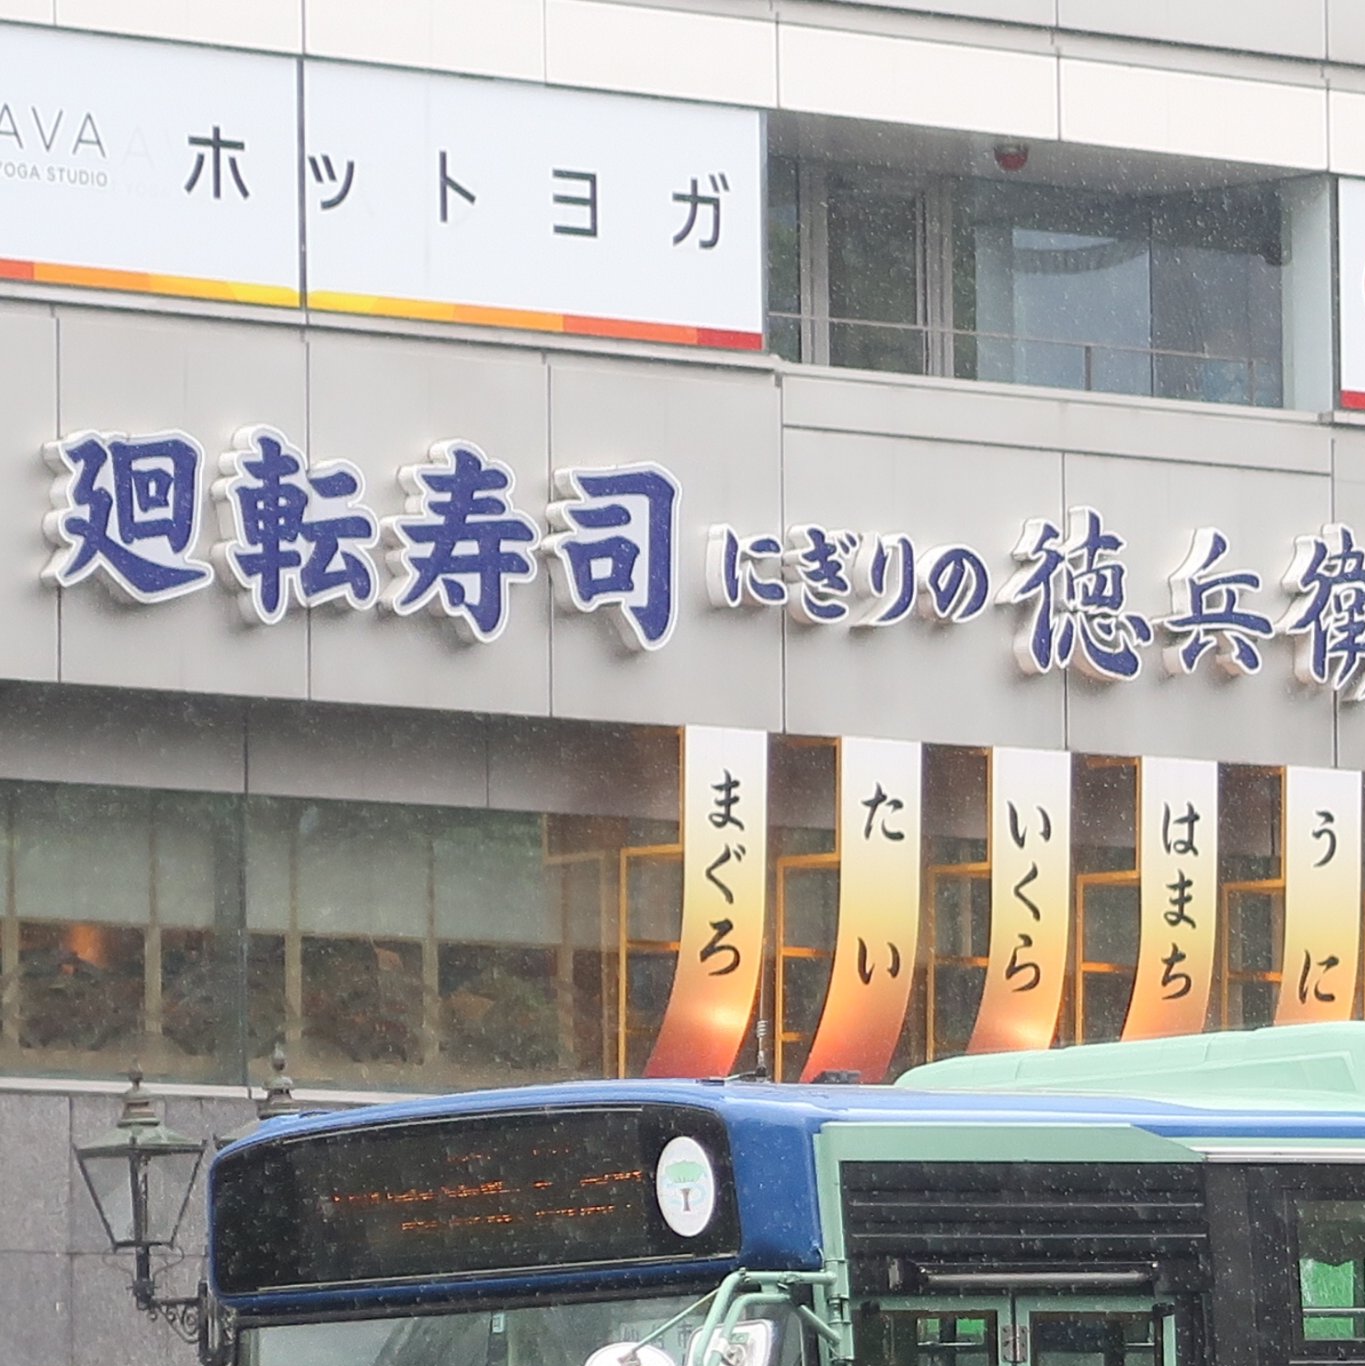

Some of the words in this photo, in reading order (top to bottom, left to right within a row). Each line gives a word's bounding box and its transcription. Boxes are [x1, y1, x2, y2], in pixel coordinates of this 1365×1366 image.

[0, 160, 41, 181] OGA
[47, 165, 108, 188] STUDIO
[184, 126, 732, 251] ホットヨガ
[53, 428, 682, 650] 廻転寿司
[716, 523, 991, 627] にぎりの
[695, 767, 745, 977] まぐろ
[854, 782, 907, 985] たい
[1003, 799, 1053, 995] いくら
[1160, 801, 1201, 1000] はまち
[1297, 809, 1343, 1005] うに
